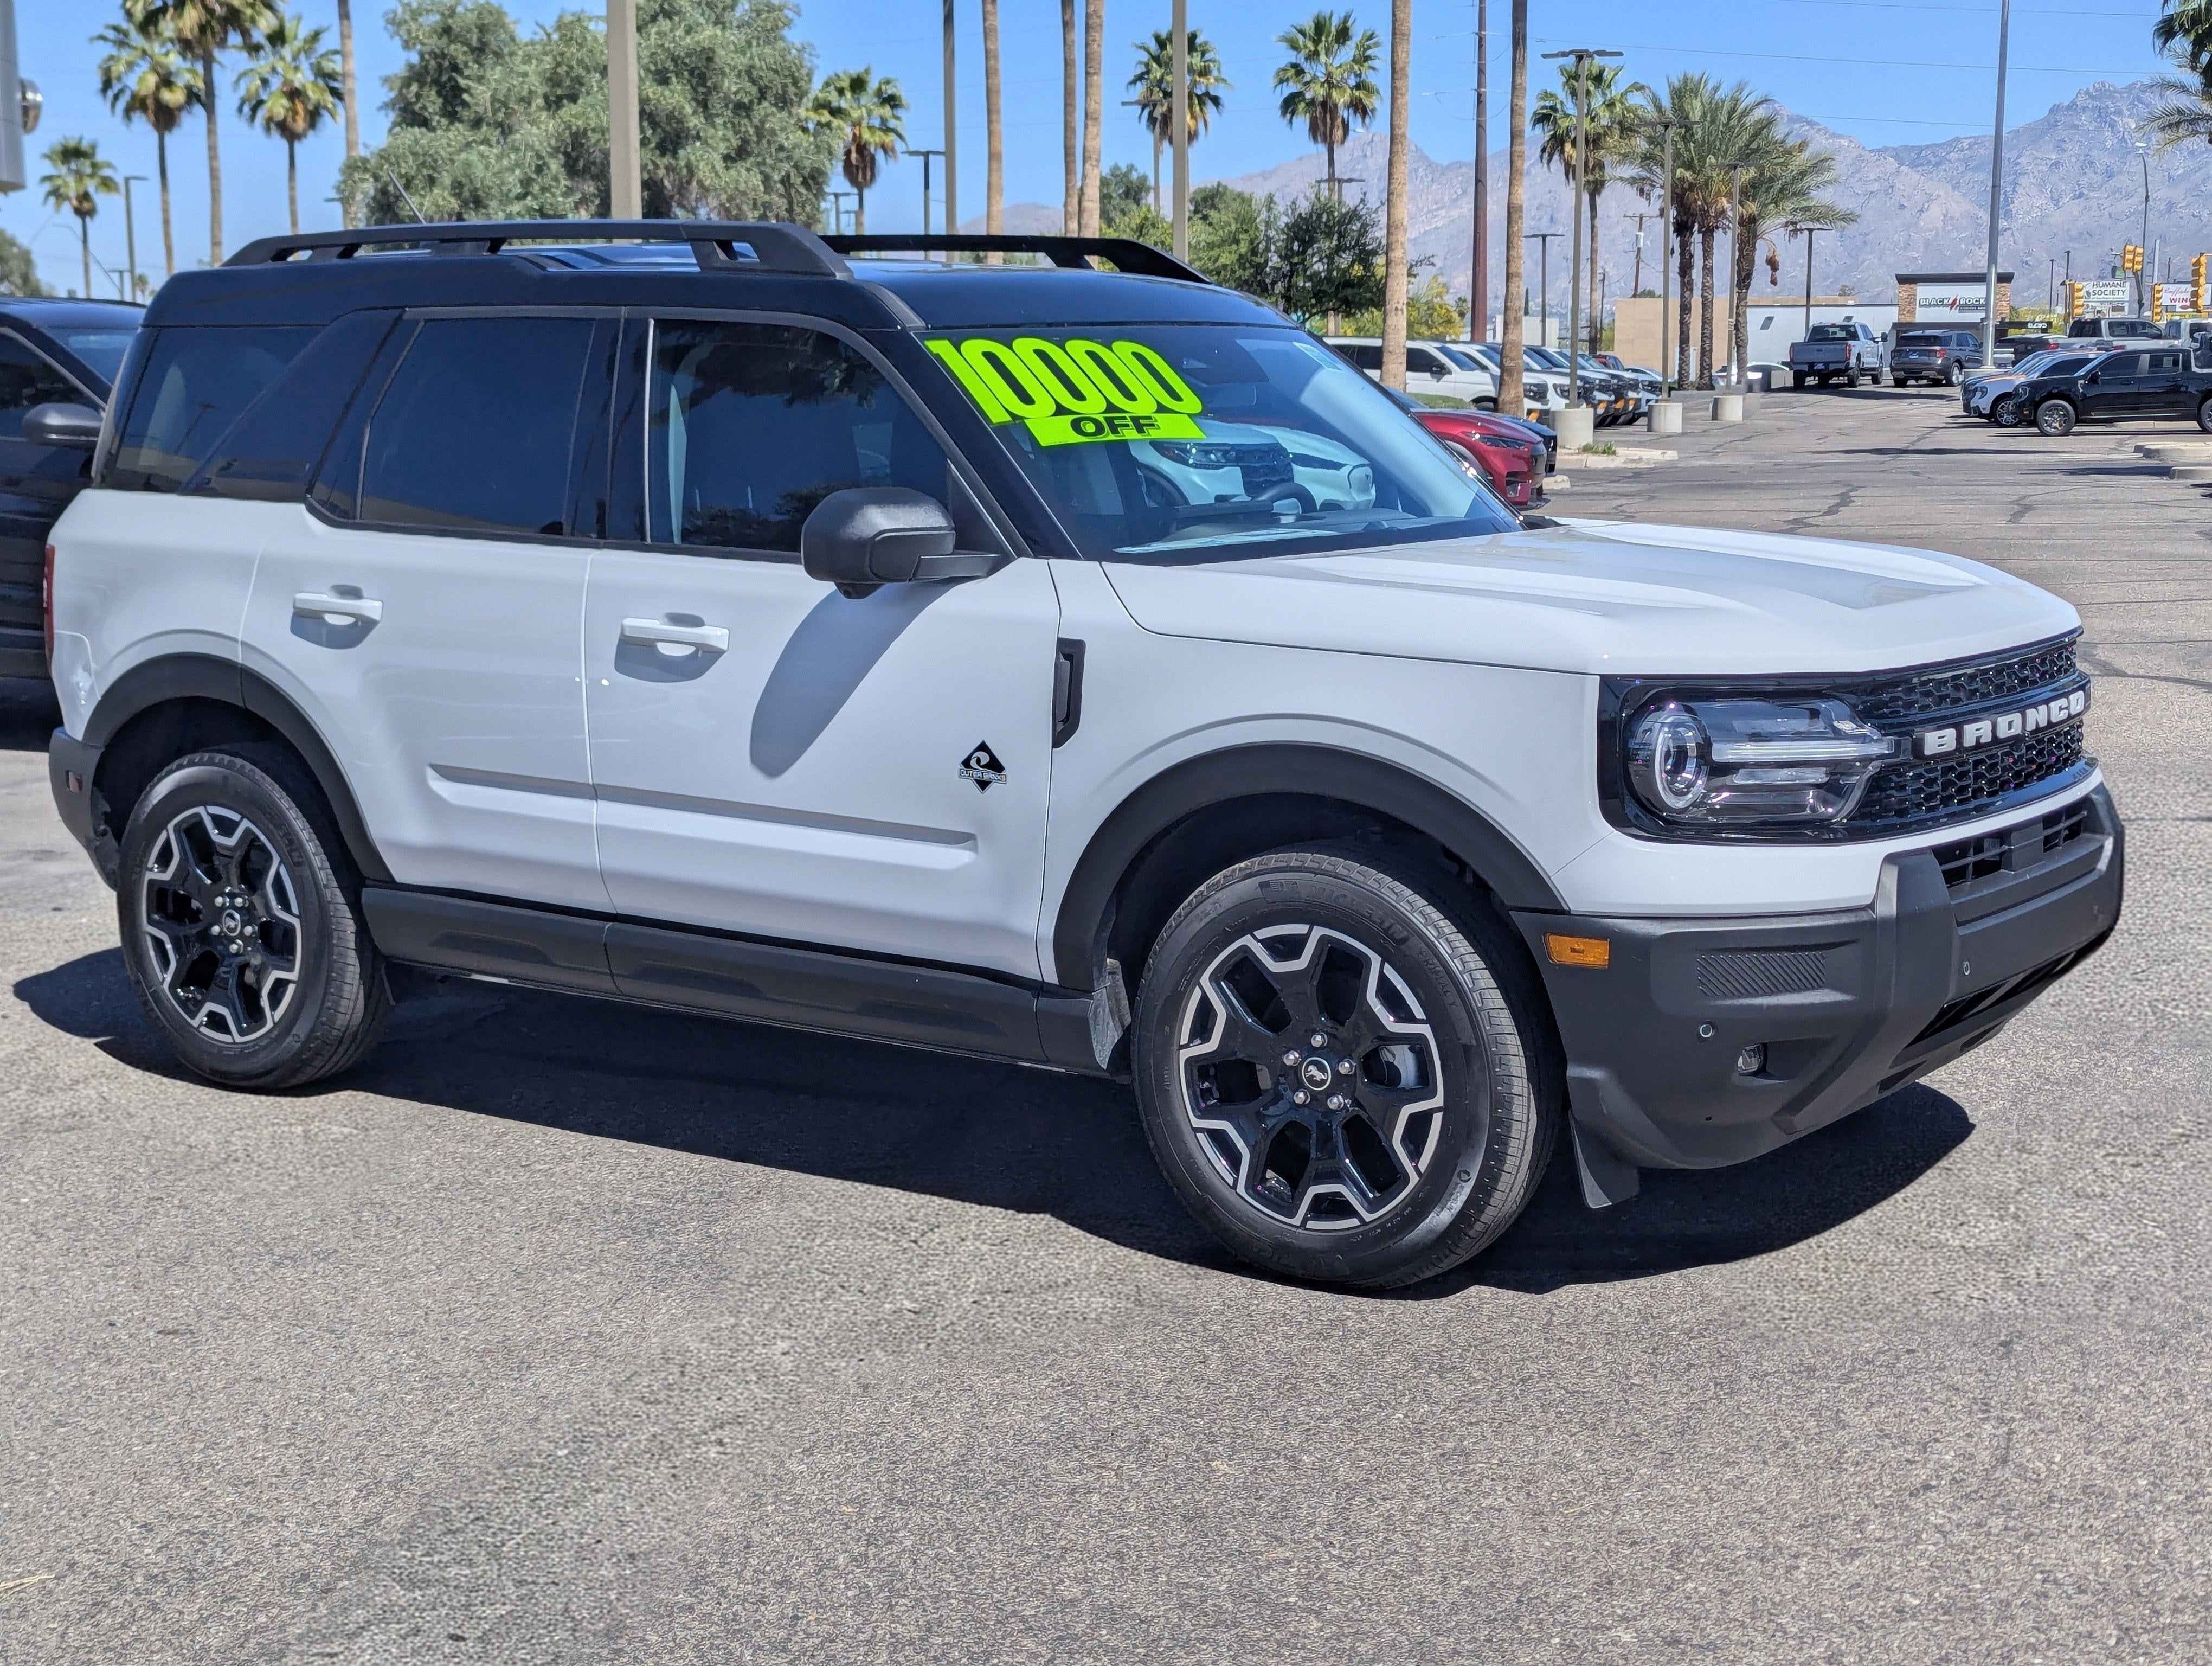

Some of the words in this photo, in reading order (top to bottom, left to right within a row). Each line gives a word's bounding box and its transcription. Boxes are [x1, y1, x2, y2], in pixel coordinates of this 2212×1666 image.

[1919, 297, 1950, 305] BLACK
[924, 337, 1203, 424] 10000
[1070, 415, 1159, 438] OFF
[1924, 690, 2085, 756] BRONCO
